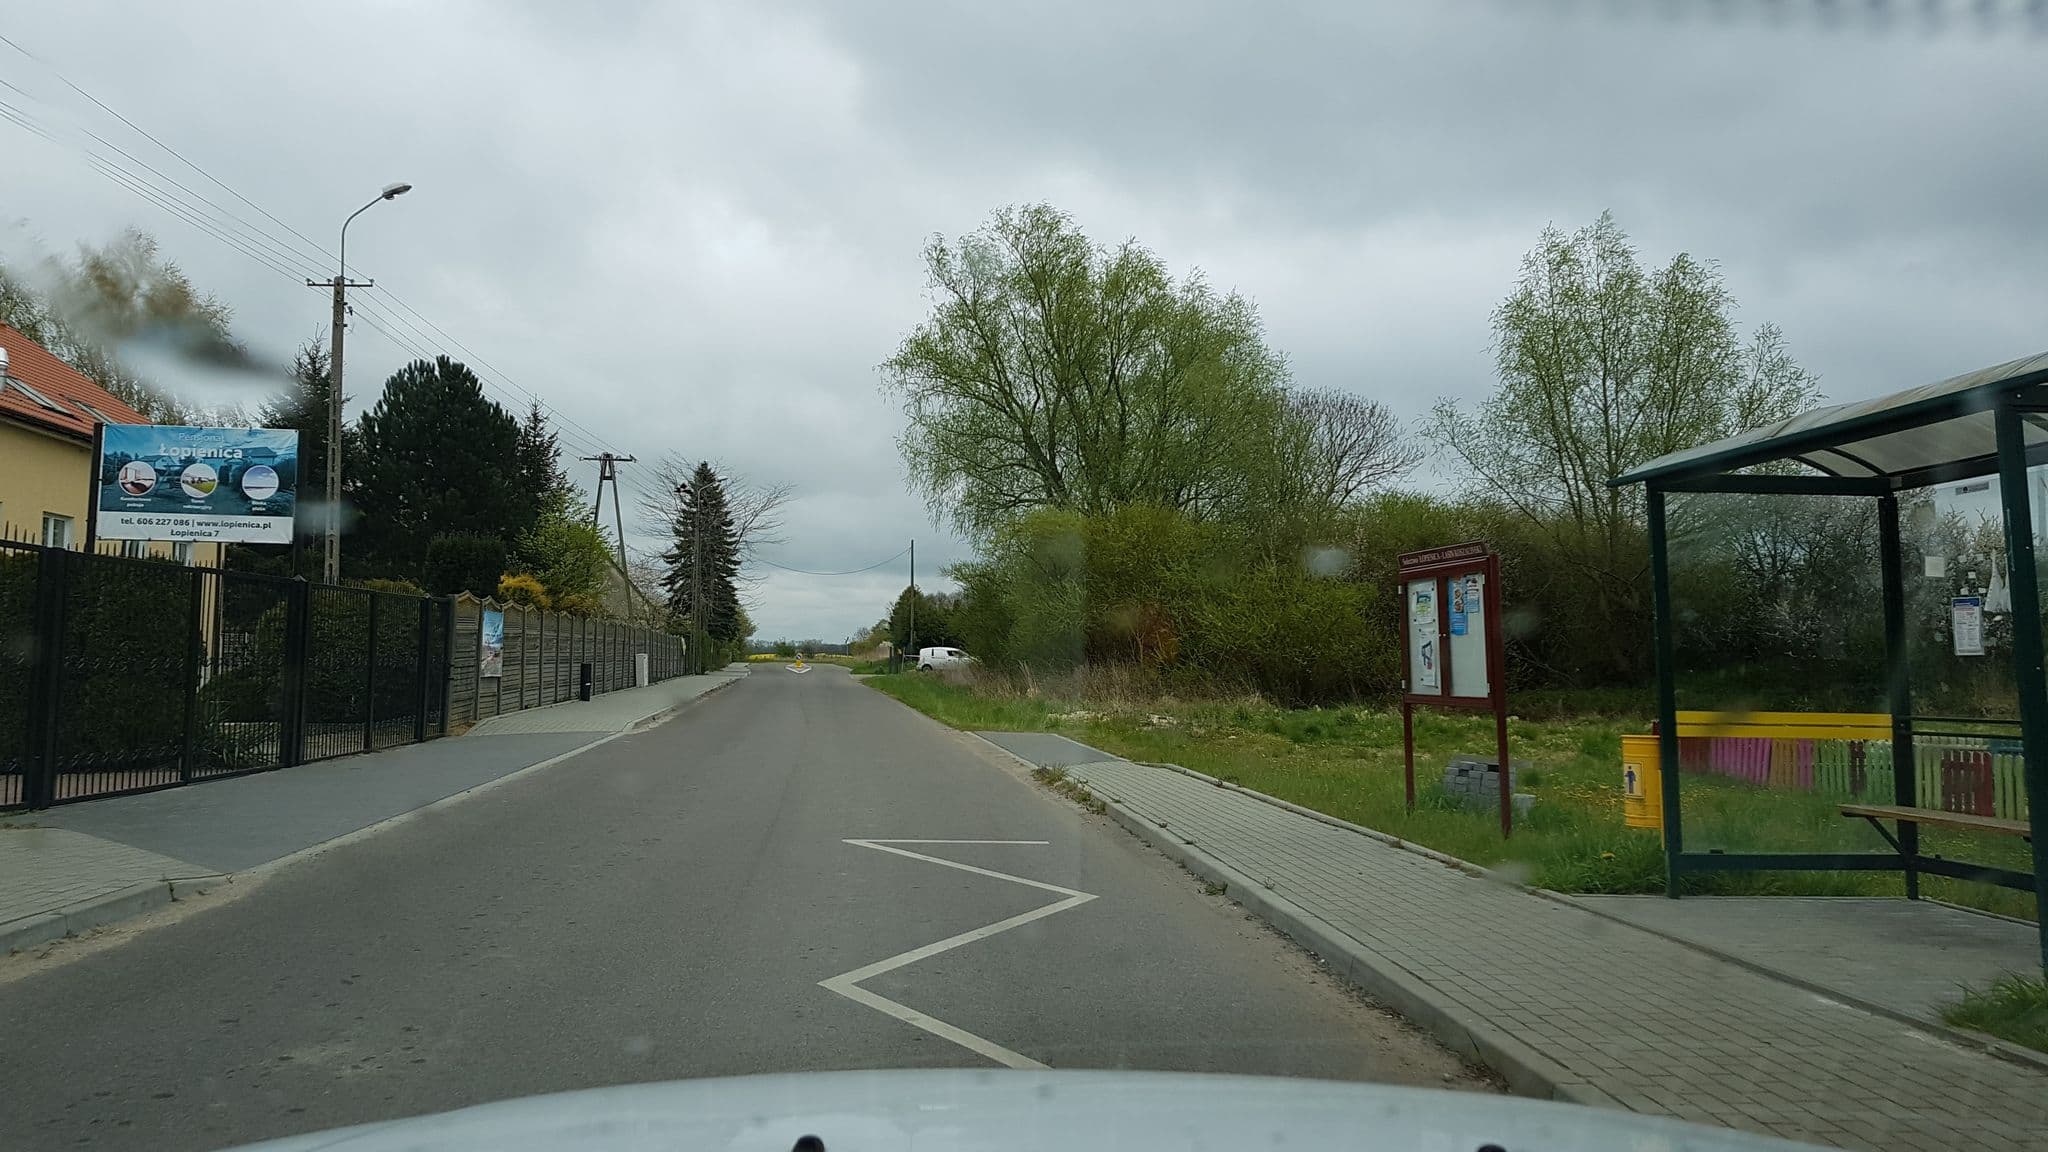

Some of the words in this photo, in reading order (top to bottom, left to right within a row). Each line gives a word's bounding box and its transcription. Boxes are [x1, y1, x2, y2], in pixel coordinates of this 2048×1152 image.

[159, 443, 243, 459] Łopienica
[155, 518, 171, 526] 227
[173, 519, 190, 527] 086
[196, 520, 272, 530] www.lopienica.pl
[170, 529, 213, 538] Łopienica
